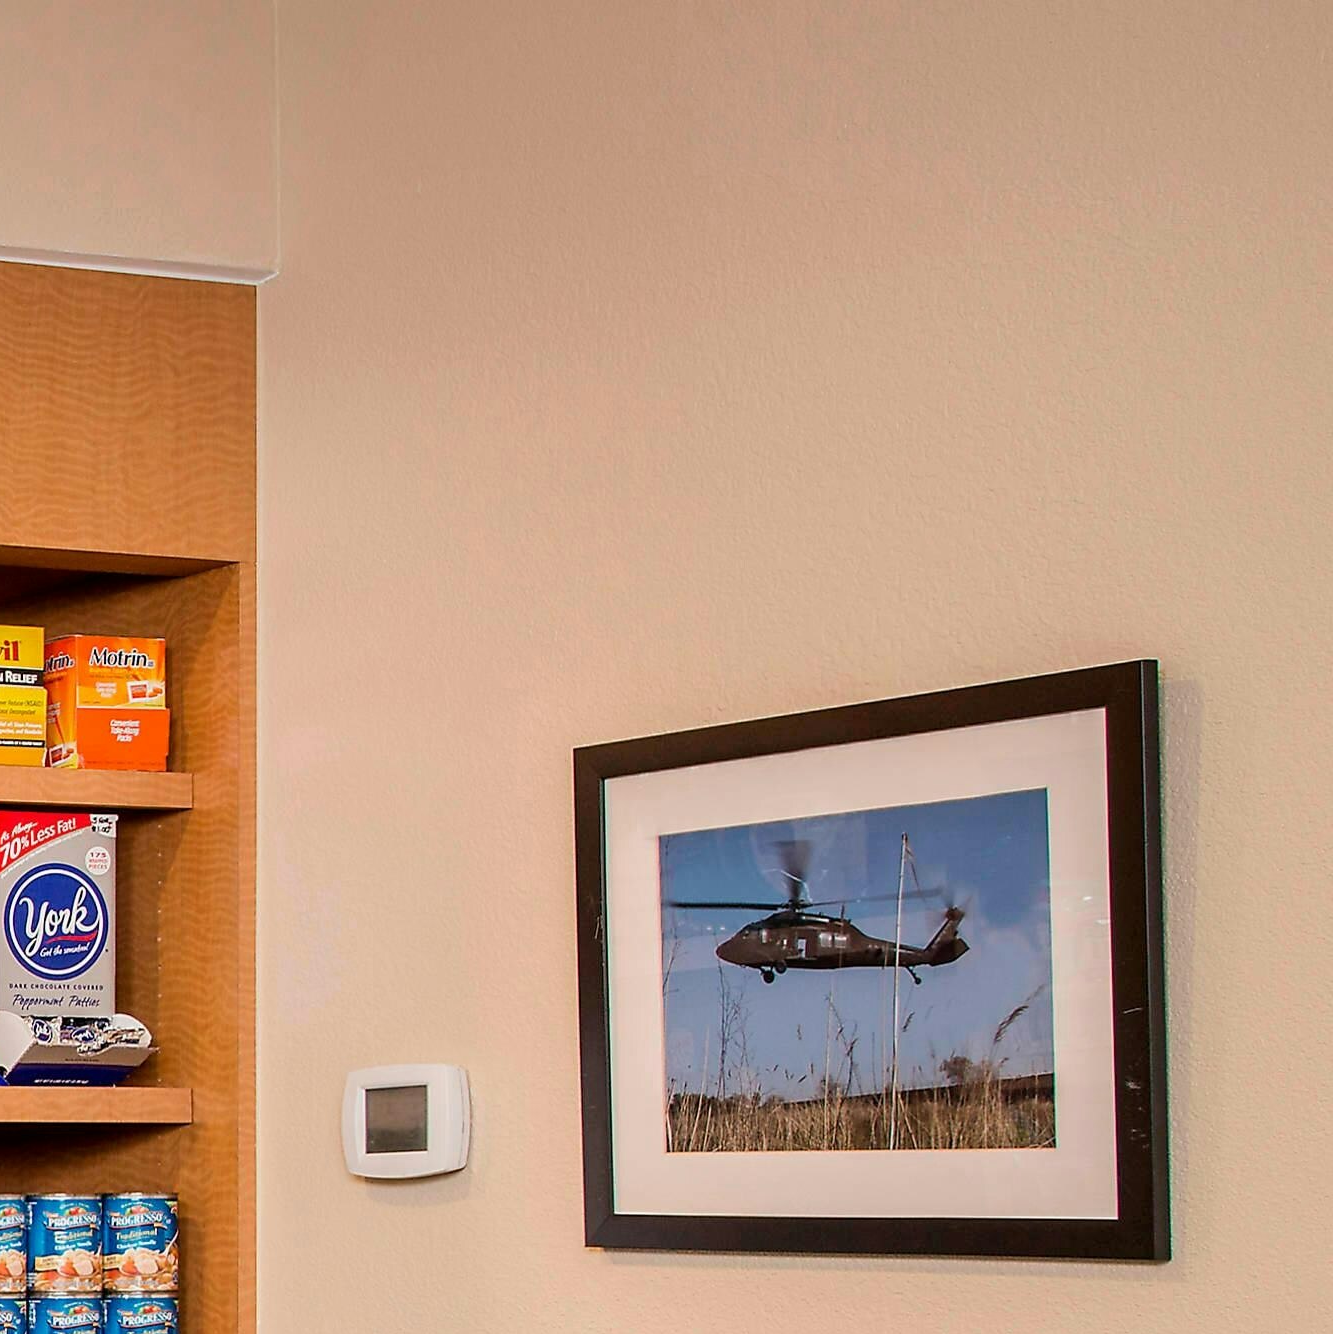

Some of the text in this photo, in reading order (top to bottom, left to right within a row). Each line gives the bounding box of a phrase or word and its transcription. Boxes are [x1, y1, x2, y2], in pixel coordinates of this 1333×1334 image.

[90, 648, 148, 668] Motrin
[5, 670, 38, 684] RELIEF
[0, 817, 77, 868] 70% Less Fat!
[18, 885, 103, 958] York
